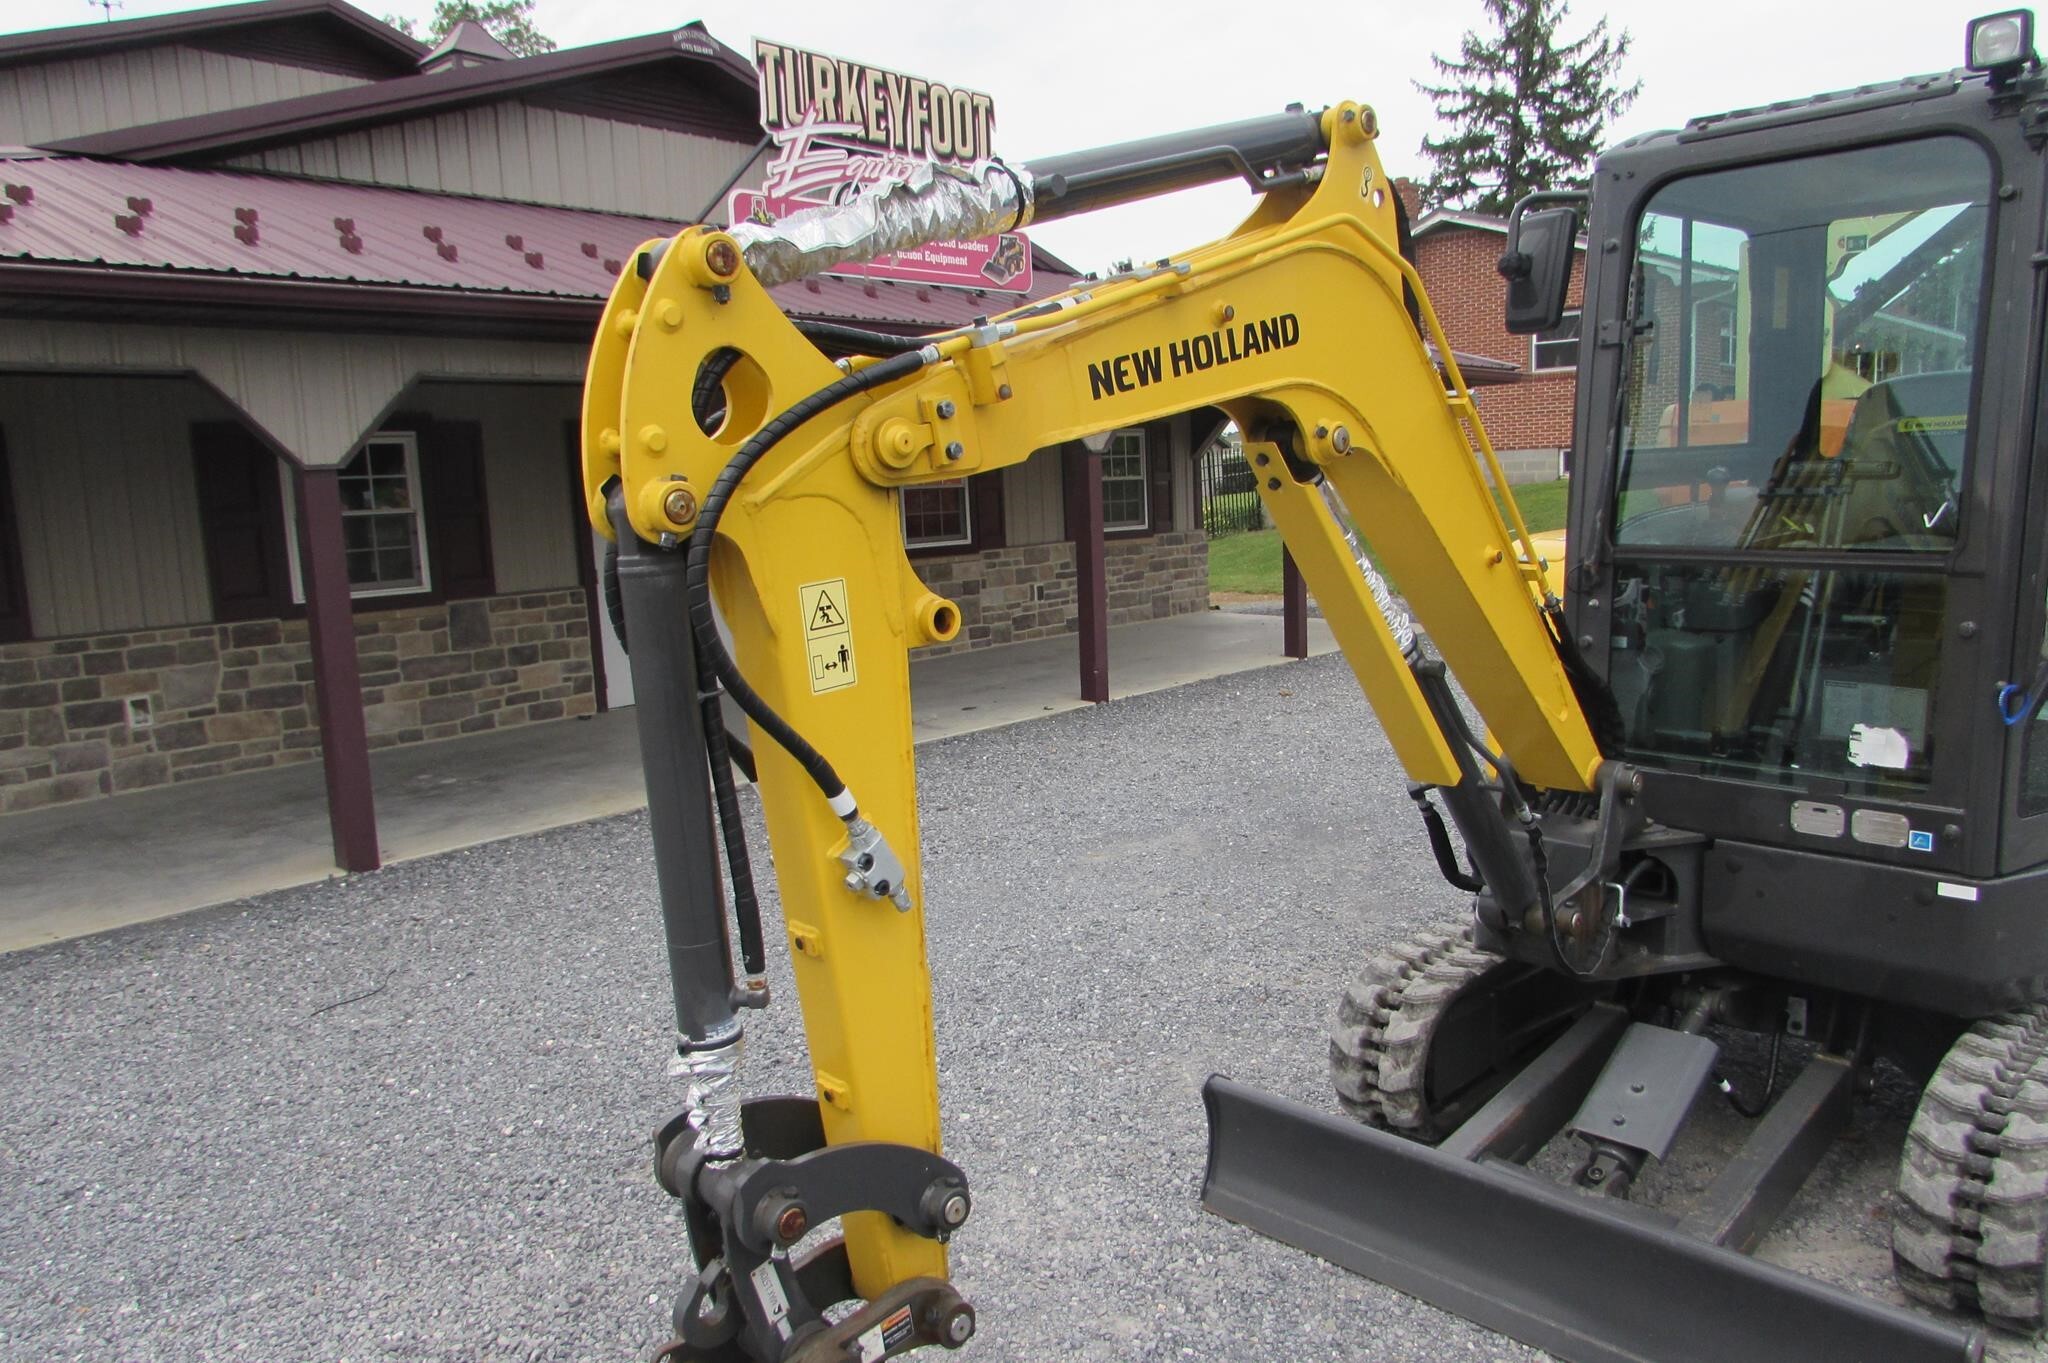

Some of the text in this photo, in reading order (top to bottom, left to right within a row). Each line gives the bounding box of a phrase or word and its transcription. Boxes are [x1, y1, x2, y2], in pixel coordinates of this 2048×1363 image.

[755, 38, 996, 162] TURKEYFOOT
[771, 106, 920, 204] Equip
[925, 250, 968, 266] Equipment
[1088, 313, 1300, 400] NEW HOLLAND
